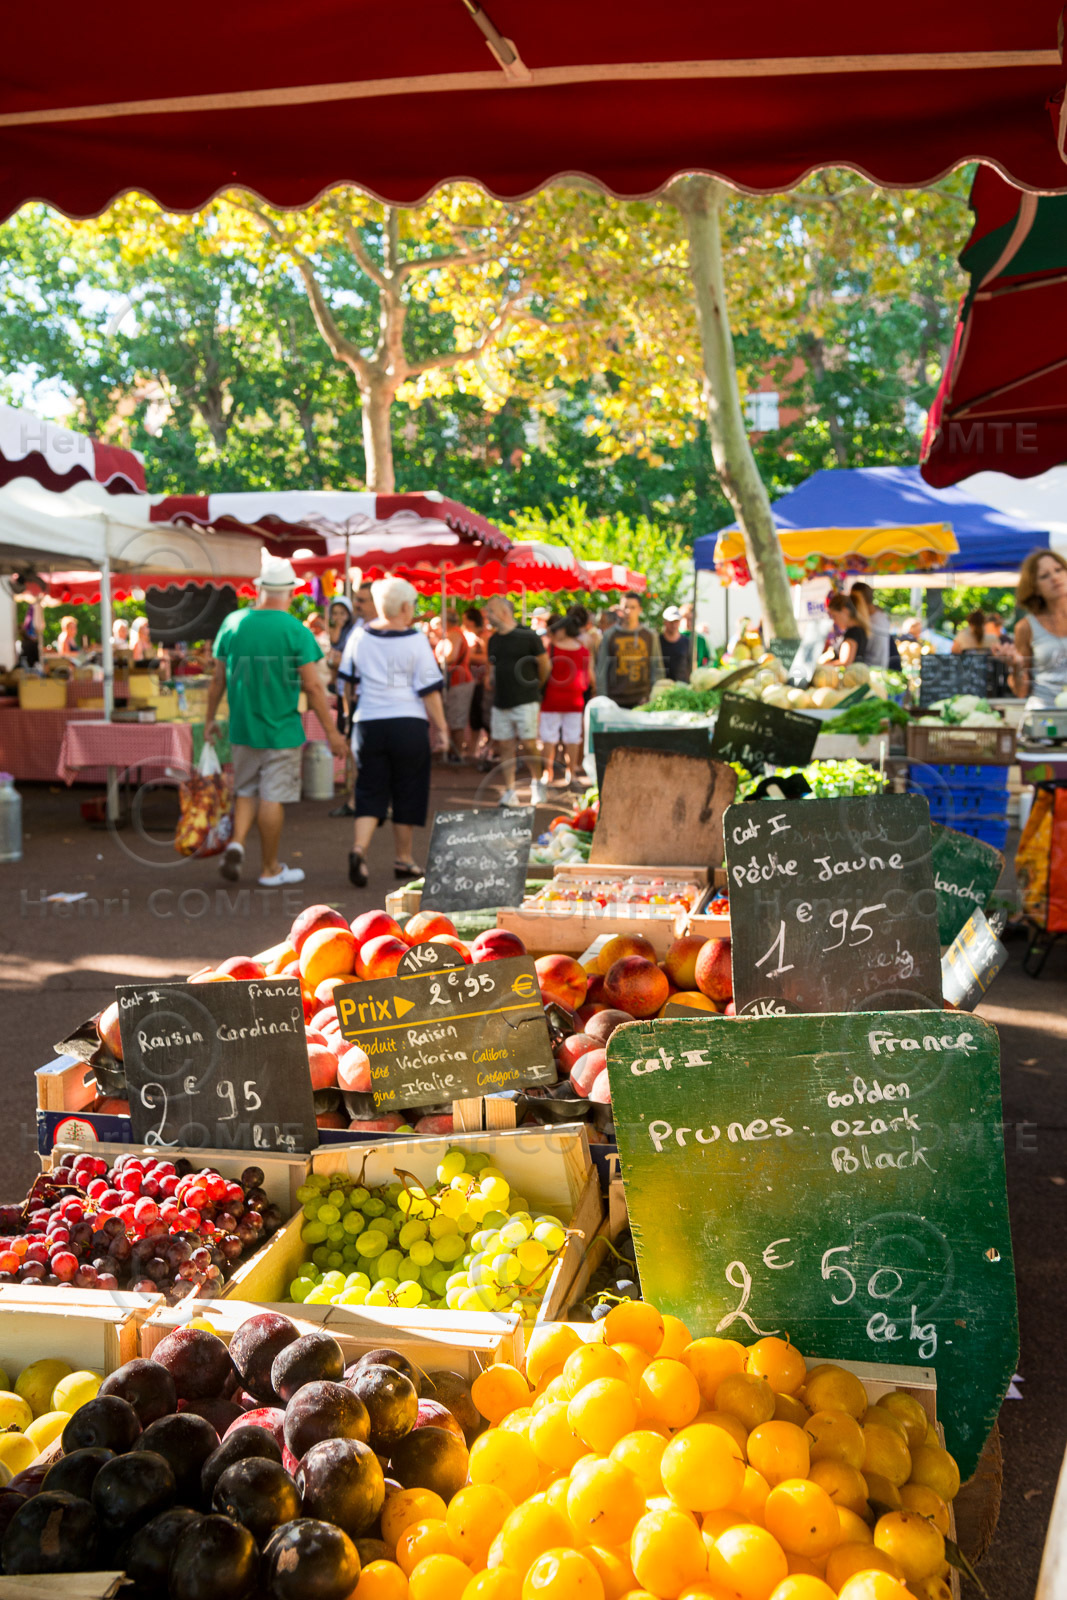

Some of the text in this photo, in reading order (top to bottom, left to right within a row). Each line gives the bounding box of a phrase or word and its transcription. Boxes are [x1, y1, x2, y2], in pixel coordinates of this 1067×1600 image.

[732, 853, 799, 888] Pêche
[814, 852, 905, 882] Jaune
[934, 871, 987, 905] lanche
[404, 945, 439, 973] 1Kg
[247, 983, 301, 1000] France
[339, 995, 392, 1026] Prix
[137, 1006, 301, 1053] Raisin Cardinal
[407, 1023, 458, 1048] Raisin
[867, 1030, 978, 1058] France
[396, 1049, 468, 1071] Victoria
[373, 1089, 396, 1108] gine
[831, 1136, 938, 1175] Black
